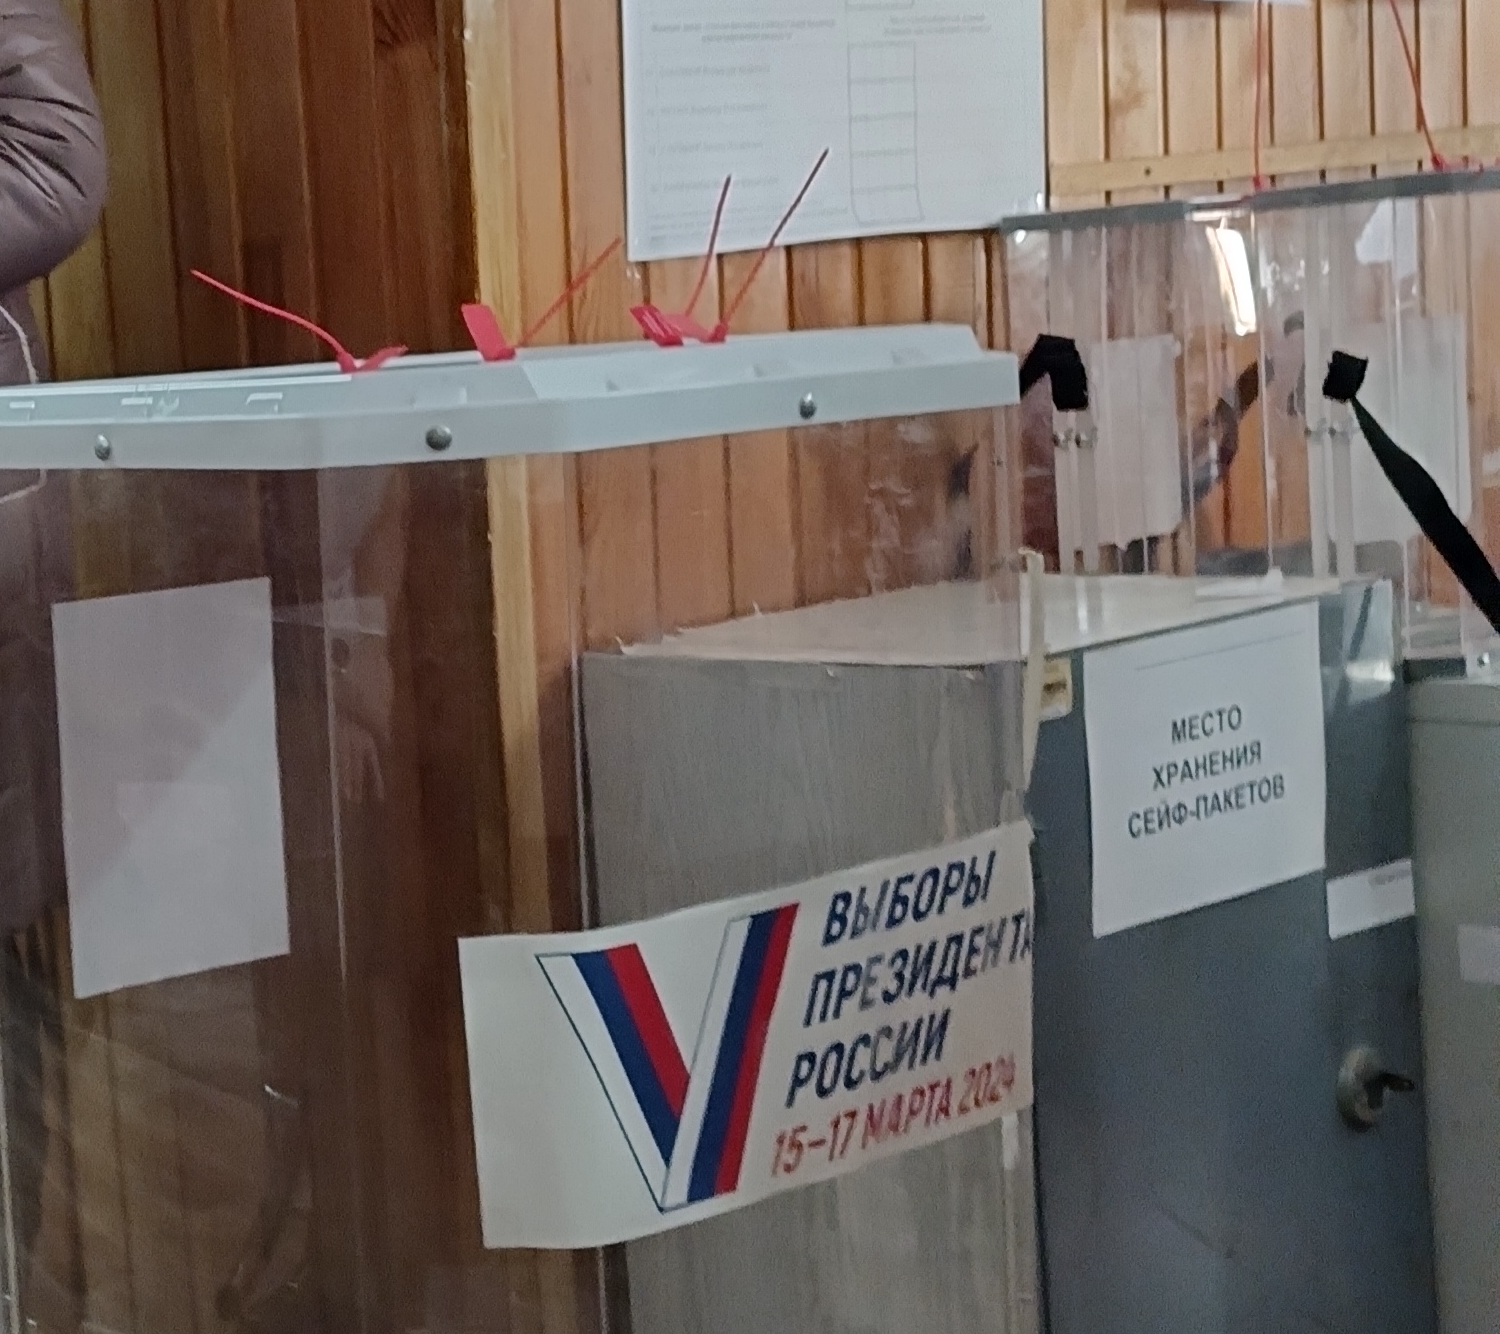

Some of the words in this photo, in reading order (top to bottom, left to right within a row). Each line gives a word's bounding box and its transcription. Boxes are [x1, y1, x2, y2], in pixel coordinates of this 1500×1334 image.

[1171, 704, 1242, 744] МЕСТО
[1128, 772, 1285, 839] СЕЙФ-ПАКЕТОВ
[1152, 740, 1262, 791] ХРАНЕНИЯ
[821, 850, 996, 947] ВЫБОРЫ
[785, 1008, 951, 1108] РОССИИ
[861, 1077, 953, 1150] МАРТА
[957, 1052, 1017, 1116] 2024
